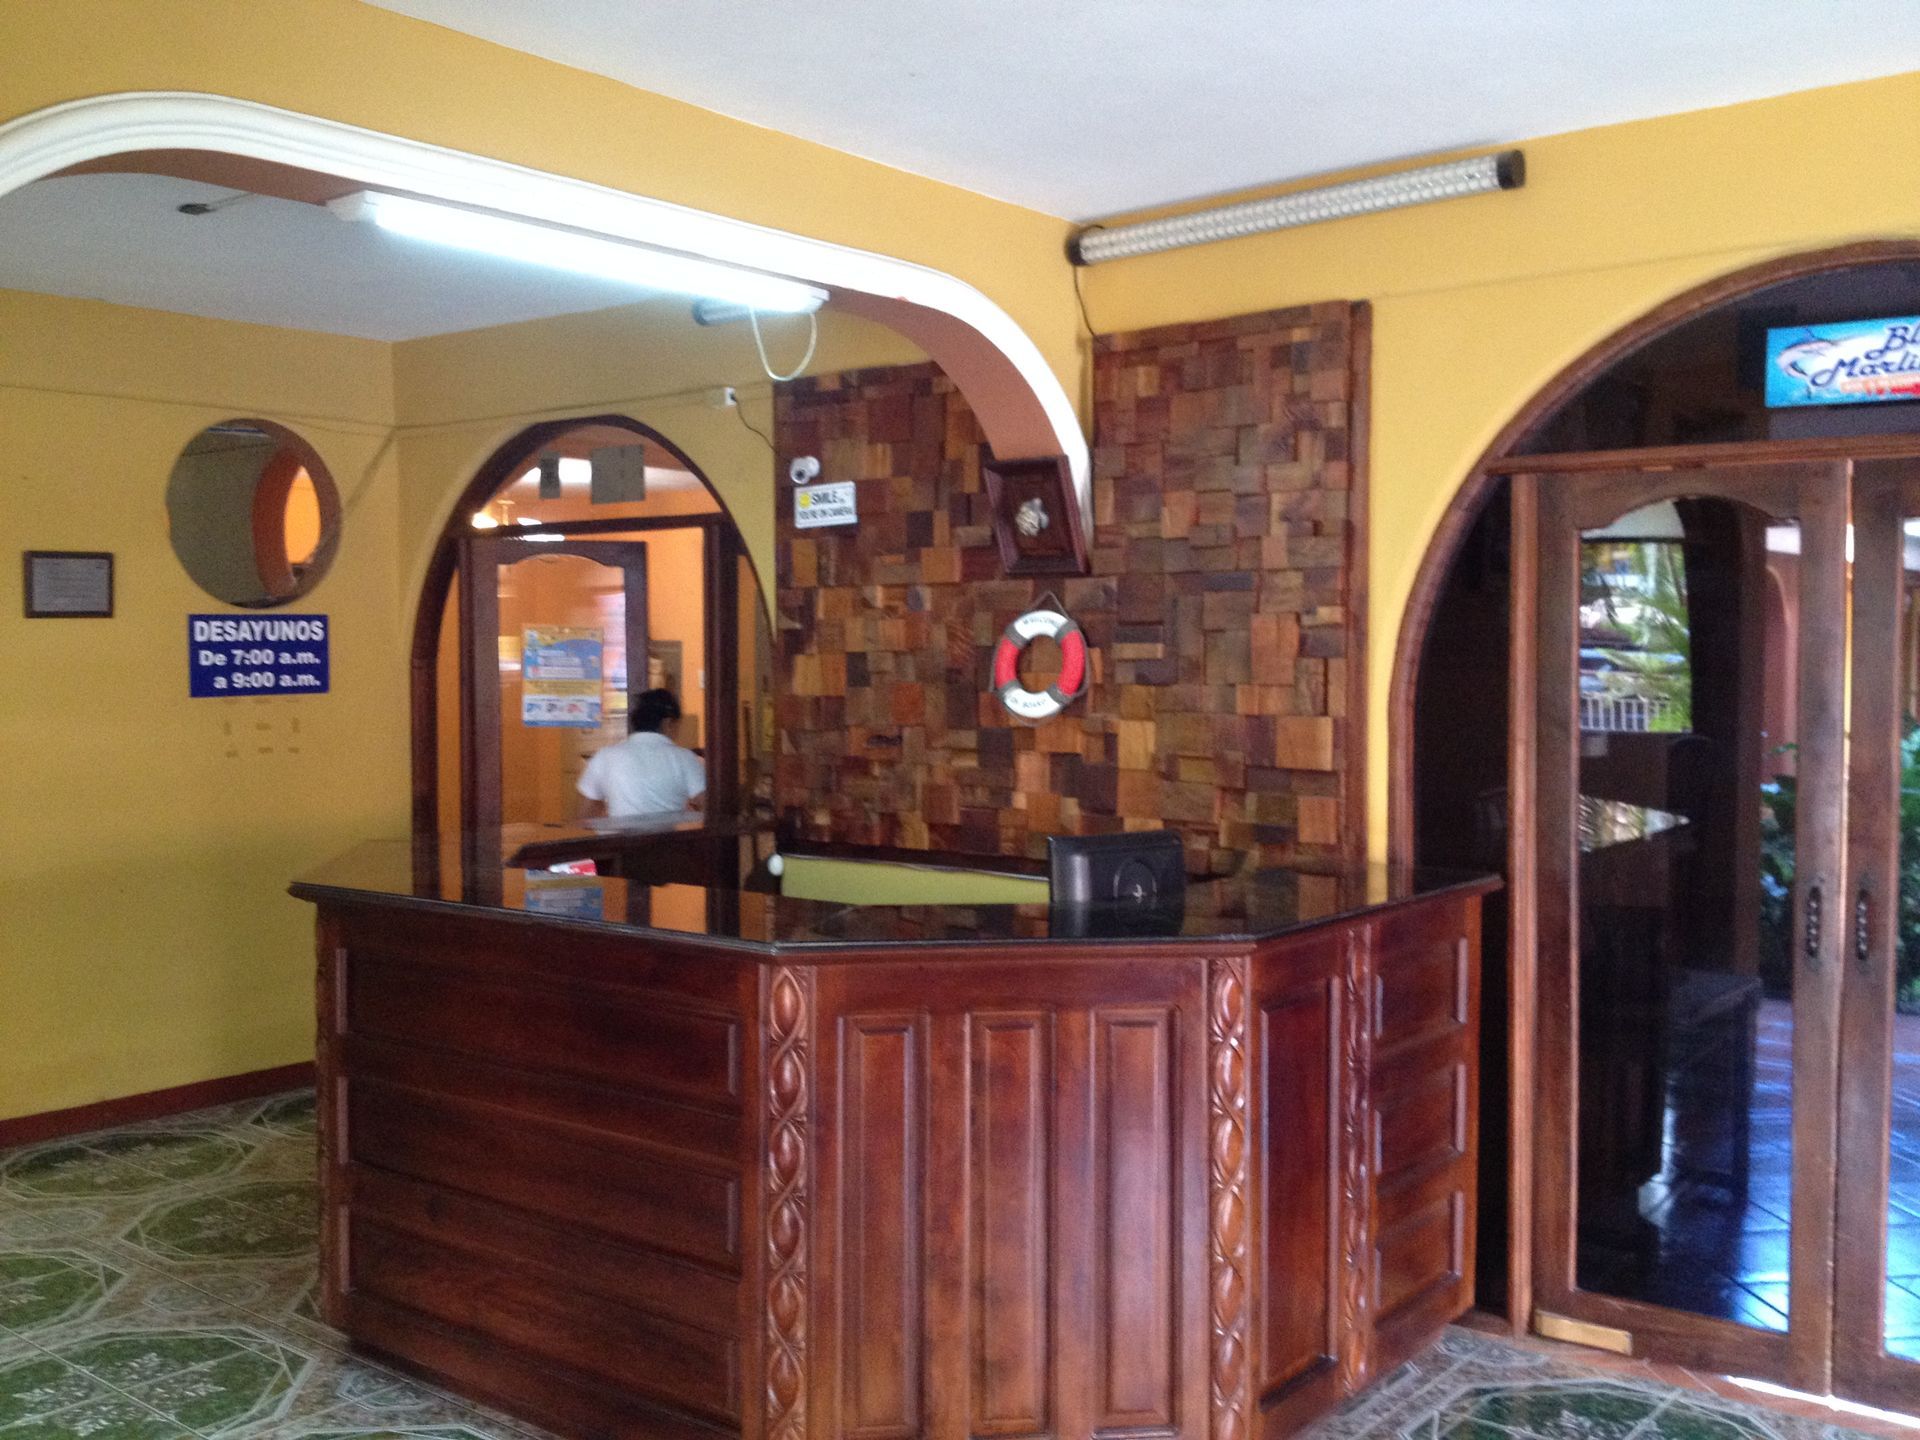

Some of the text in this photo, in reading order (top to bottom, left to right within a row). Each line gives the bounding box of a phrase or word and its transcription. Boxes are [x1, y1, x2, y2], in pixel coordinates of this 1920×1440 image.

[193, 620, 325, 642] DESAYUNOS
[198, 648, 321, 666] De 7:00 a.m.
[213, 671, 321, 689] a 9:00 a.m.
